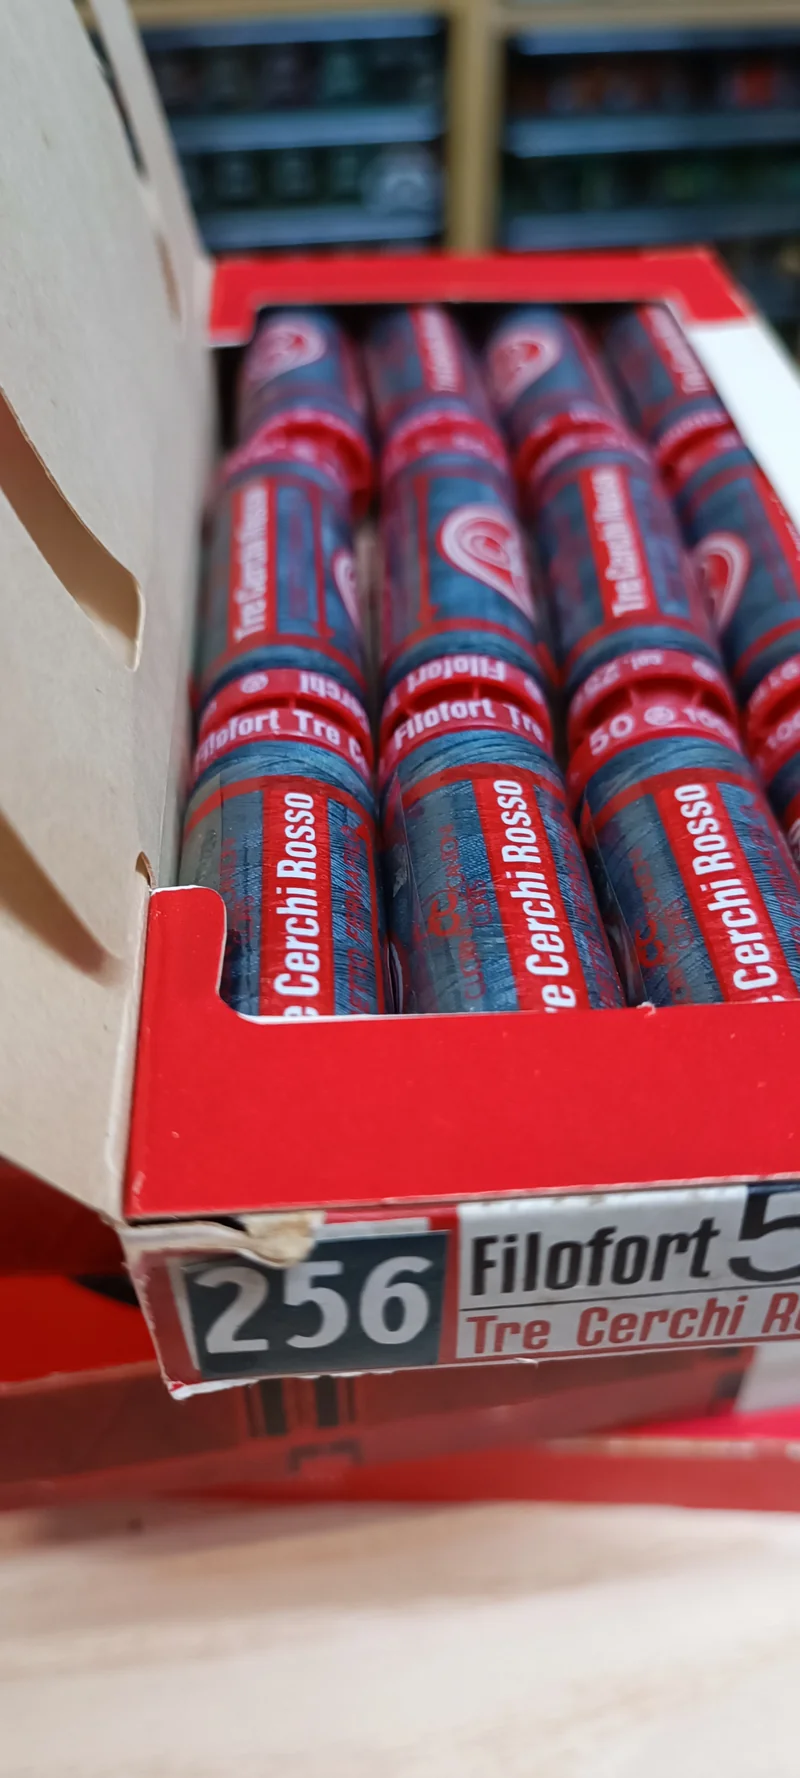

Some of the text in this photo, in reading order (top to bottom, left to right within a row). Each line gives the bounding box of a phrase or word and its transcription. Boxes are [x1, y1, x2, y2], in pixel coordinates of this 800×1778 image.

[292, 708, 341, 746] Tre
[394, 697, 496, 751] Filofort
[501, 703, 545, 744] Tre
[589, 713, 635, 756] 50
[276, 791, 316, 881] Rosso
[493, 779, 542, 864] Rosso
[674, 783, 736, 876] Rosso
[274, 886, 320, 998] Cerchi
[506, 871, 570, 977] Cerchi
[701, 878, 780, 991] Cerchi
[471, 1217, 721, 1296] Filofort
[193, 1255, 433, 1354] 256
[465, 1291, 800, 1355] Tre Cerchi R
